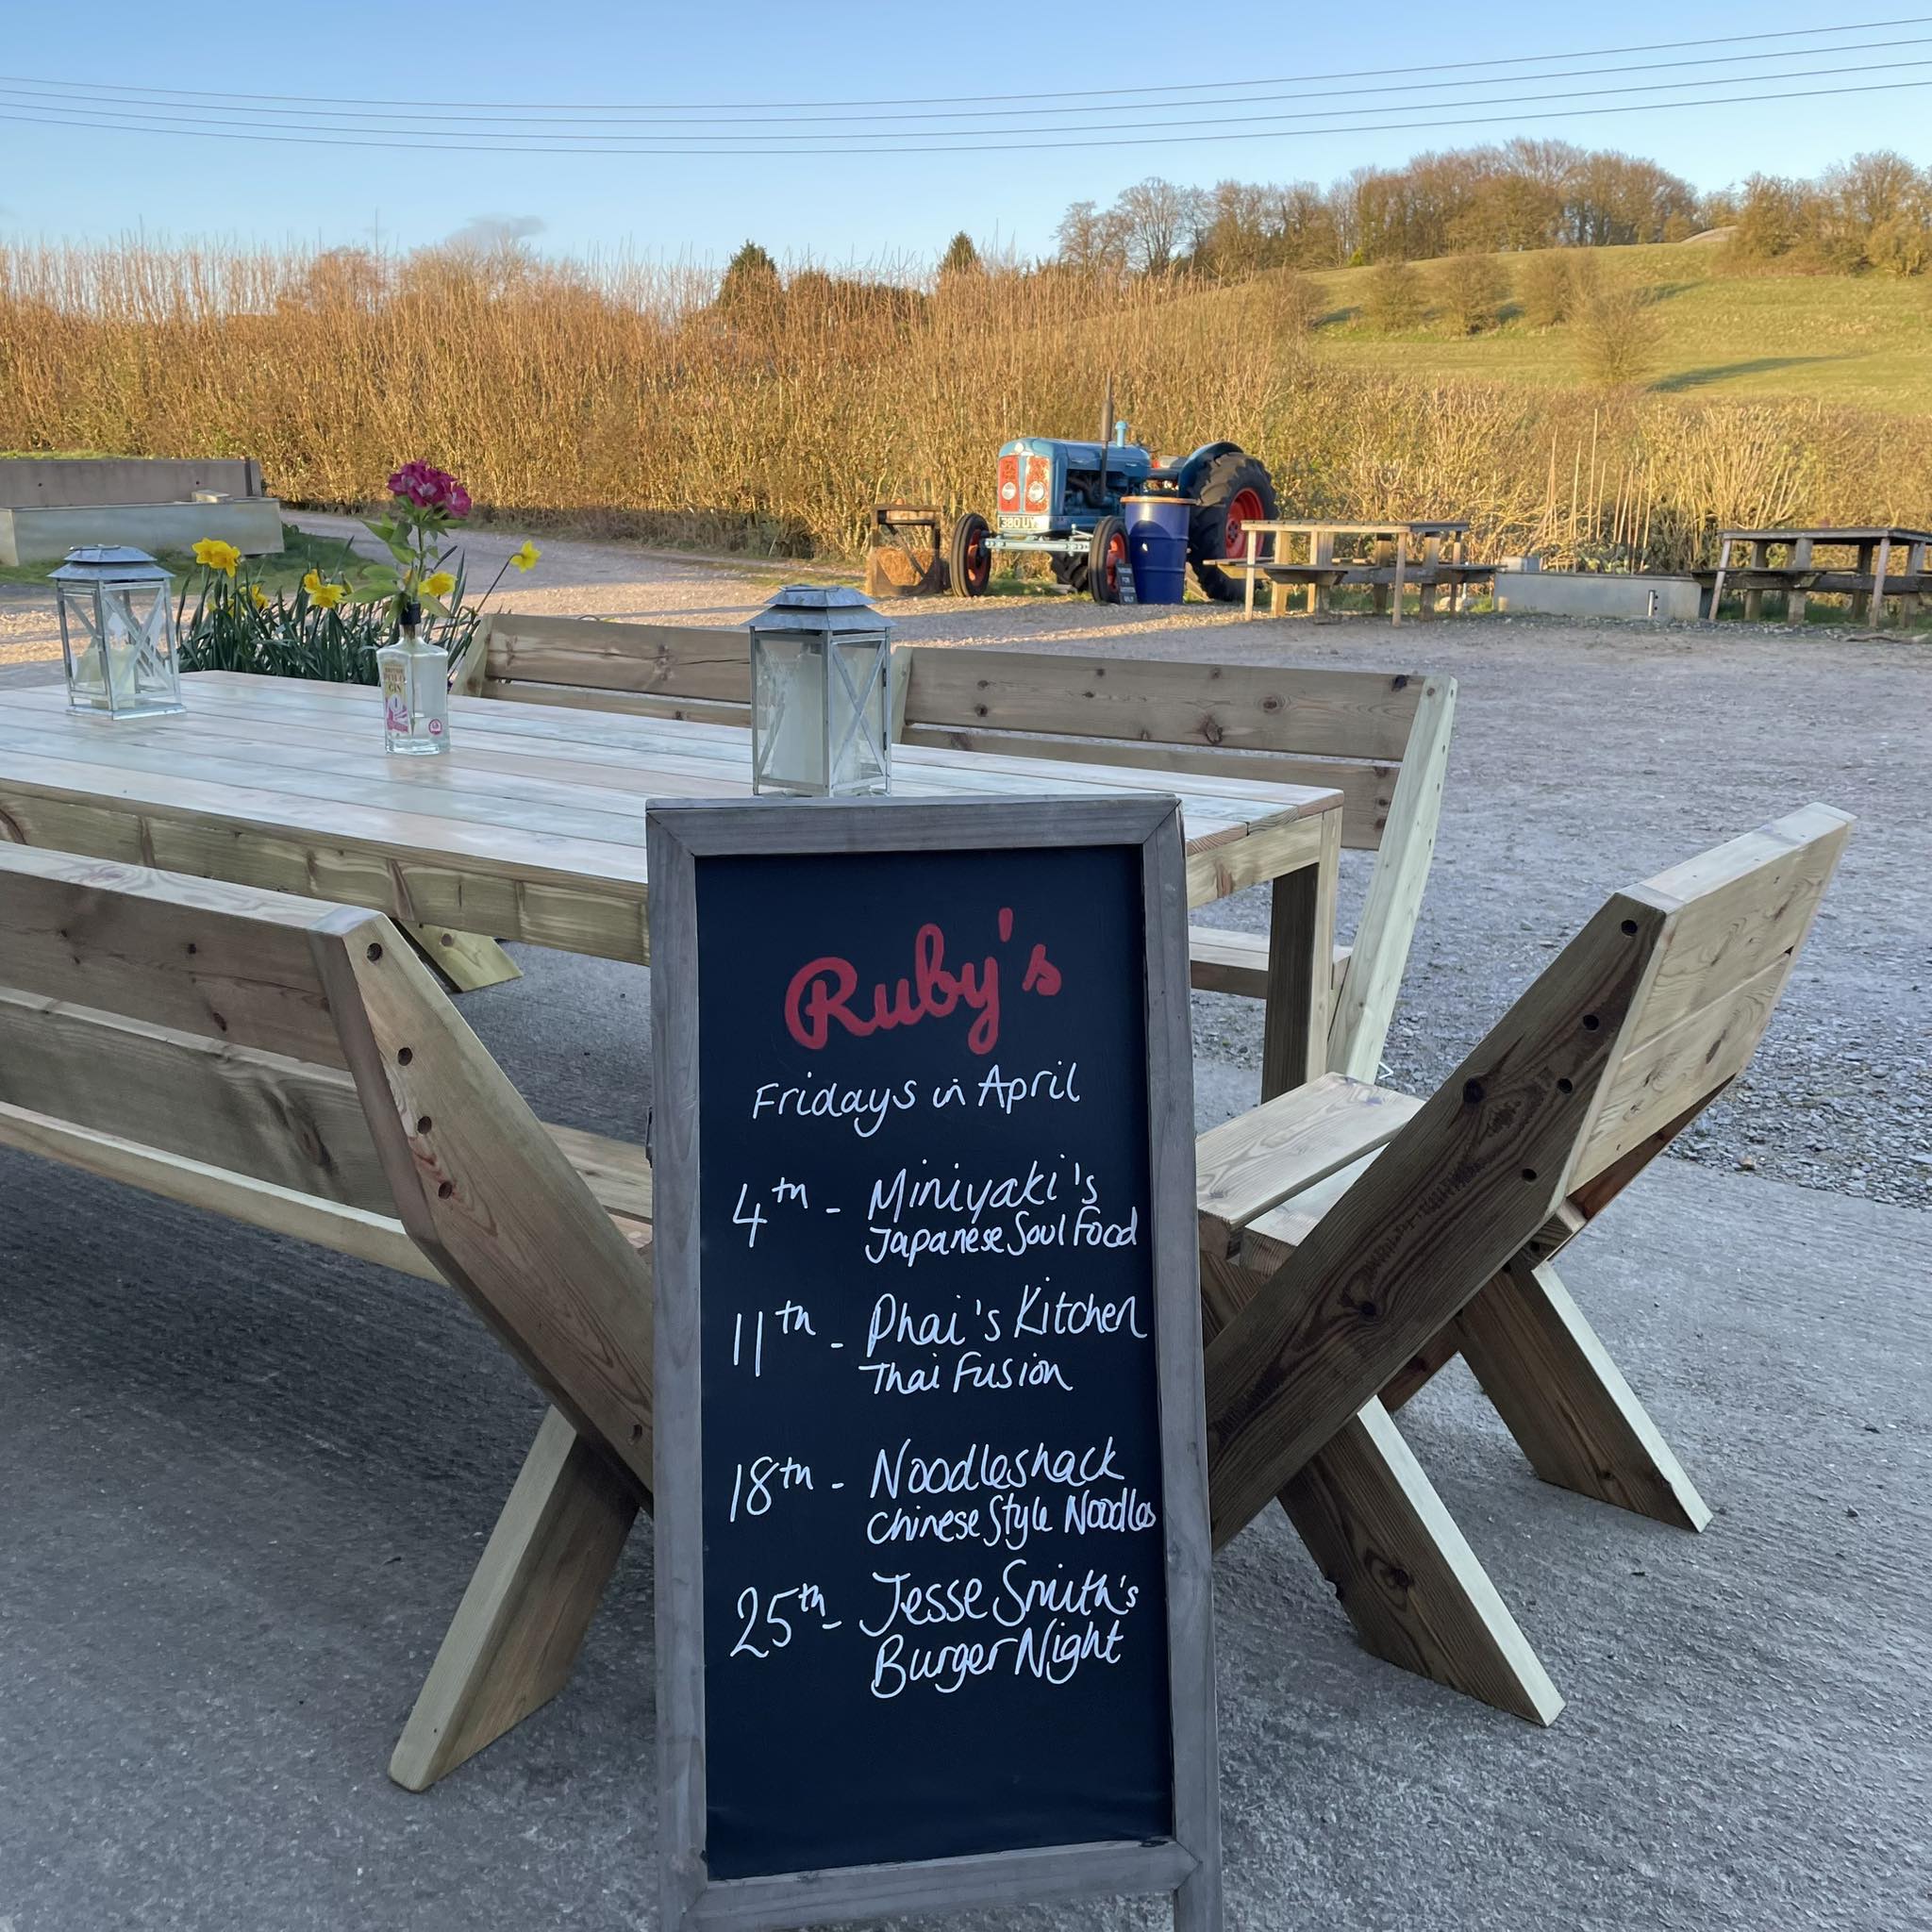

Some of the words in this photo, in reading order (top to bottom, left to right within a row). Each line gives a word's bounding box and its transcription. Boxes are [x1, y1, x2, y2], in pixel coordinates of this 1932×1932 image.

[785, 908, 1061, 1055] Ruby's
[753, 1072, 917, 1137] Fridays
[933, 1077, 966, 1108] in
[977, 1061, 1080, 1114] April
[732, 1176, 808, 1247] 4th
[868, 1154, 1097, 1224] Miniyaki's
[865, 1226, 1005, 1267] Japanese
[1007, 1211, 1066, 1257] Soul
[1073, 1205, 1138, 1248] Food
[733, 1299, 817, 1377] 11th
[866, 1292, 1001, 1358] Phai's
[1013, 1275, 1148, 1339] Kitchen
[858, 1353, 941, 1395] Thai
[952, 1351, 1074, 1393] Fusion
[729, 1456, 814, 1523] 18th
[982, 1491, 1054, 1551] Style
[1064, 1487, 1157, 1536] Noodles
[729, 1582, 826, 1658] 25th
[858, 1571, 989, 1638] Jesse
[992, 1558, 1140, 1627] Smith's
[870, 1633, 1019, 1698] Burger
[1014, 1617, 1124, 1685] Night
